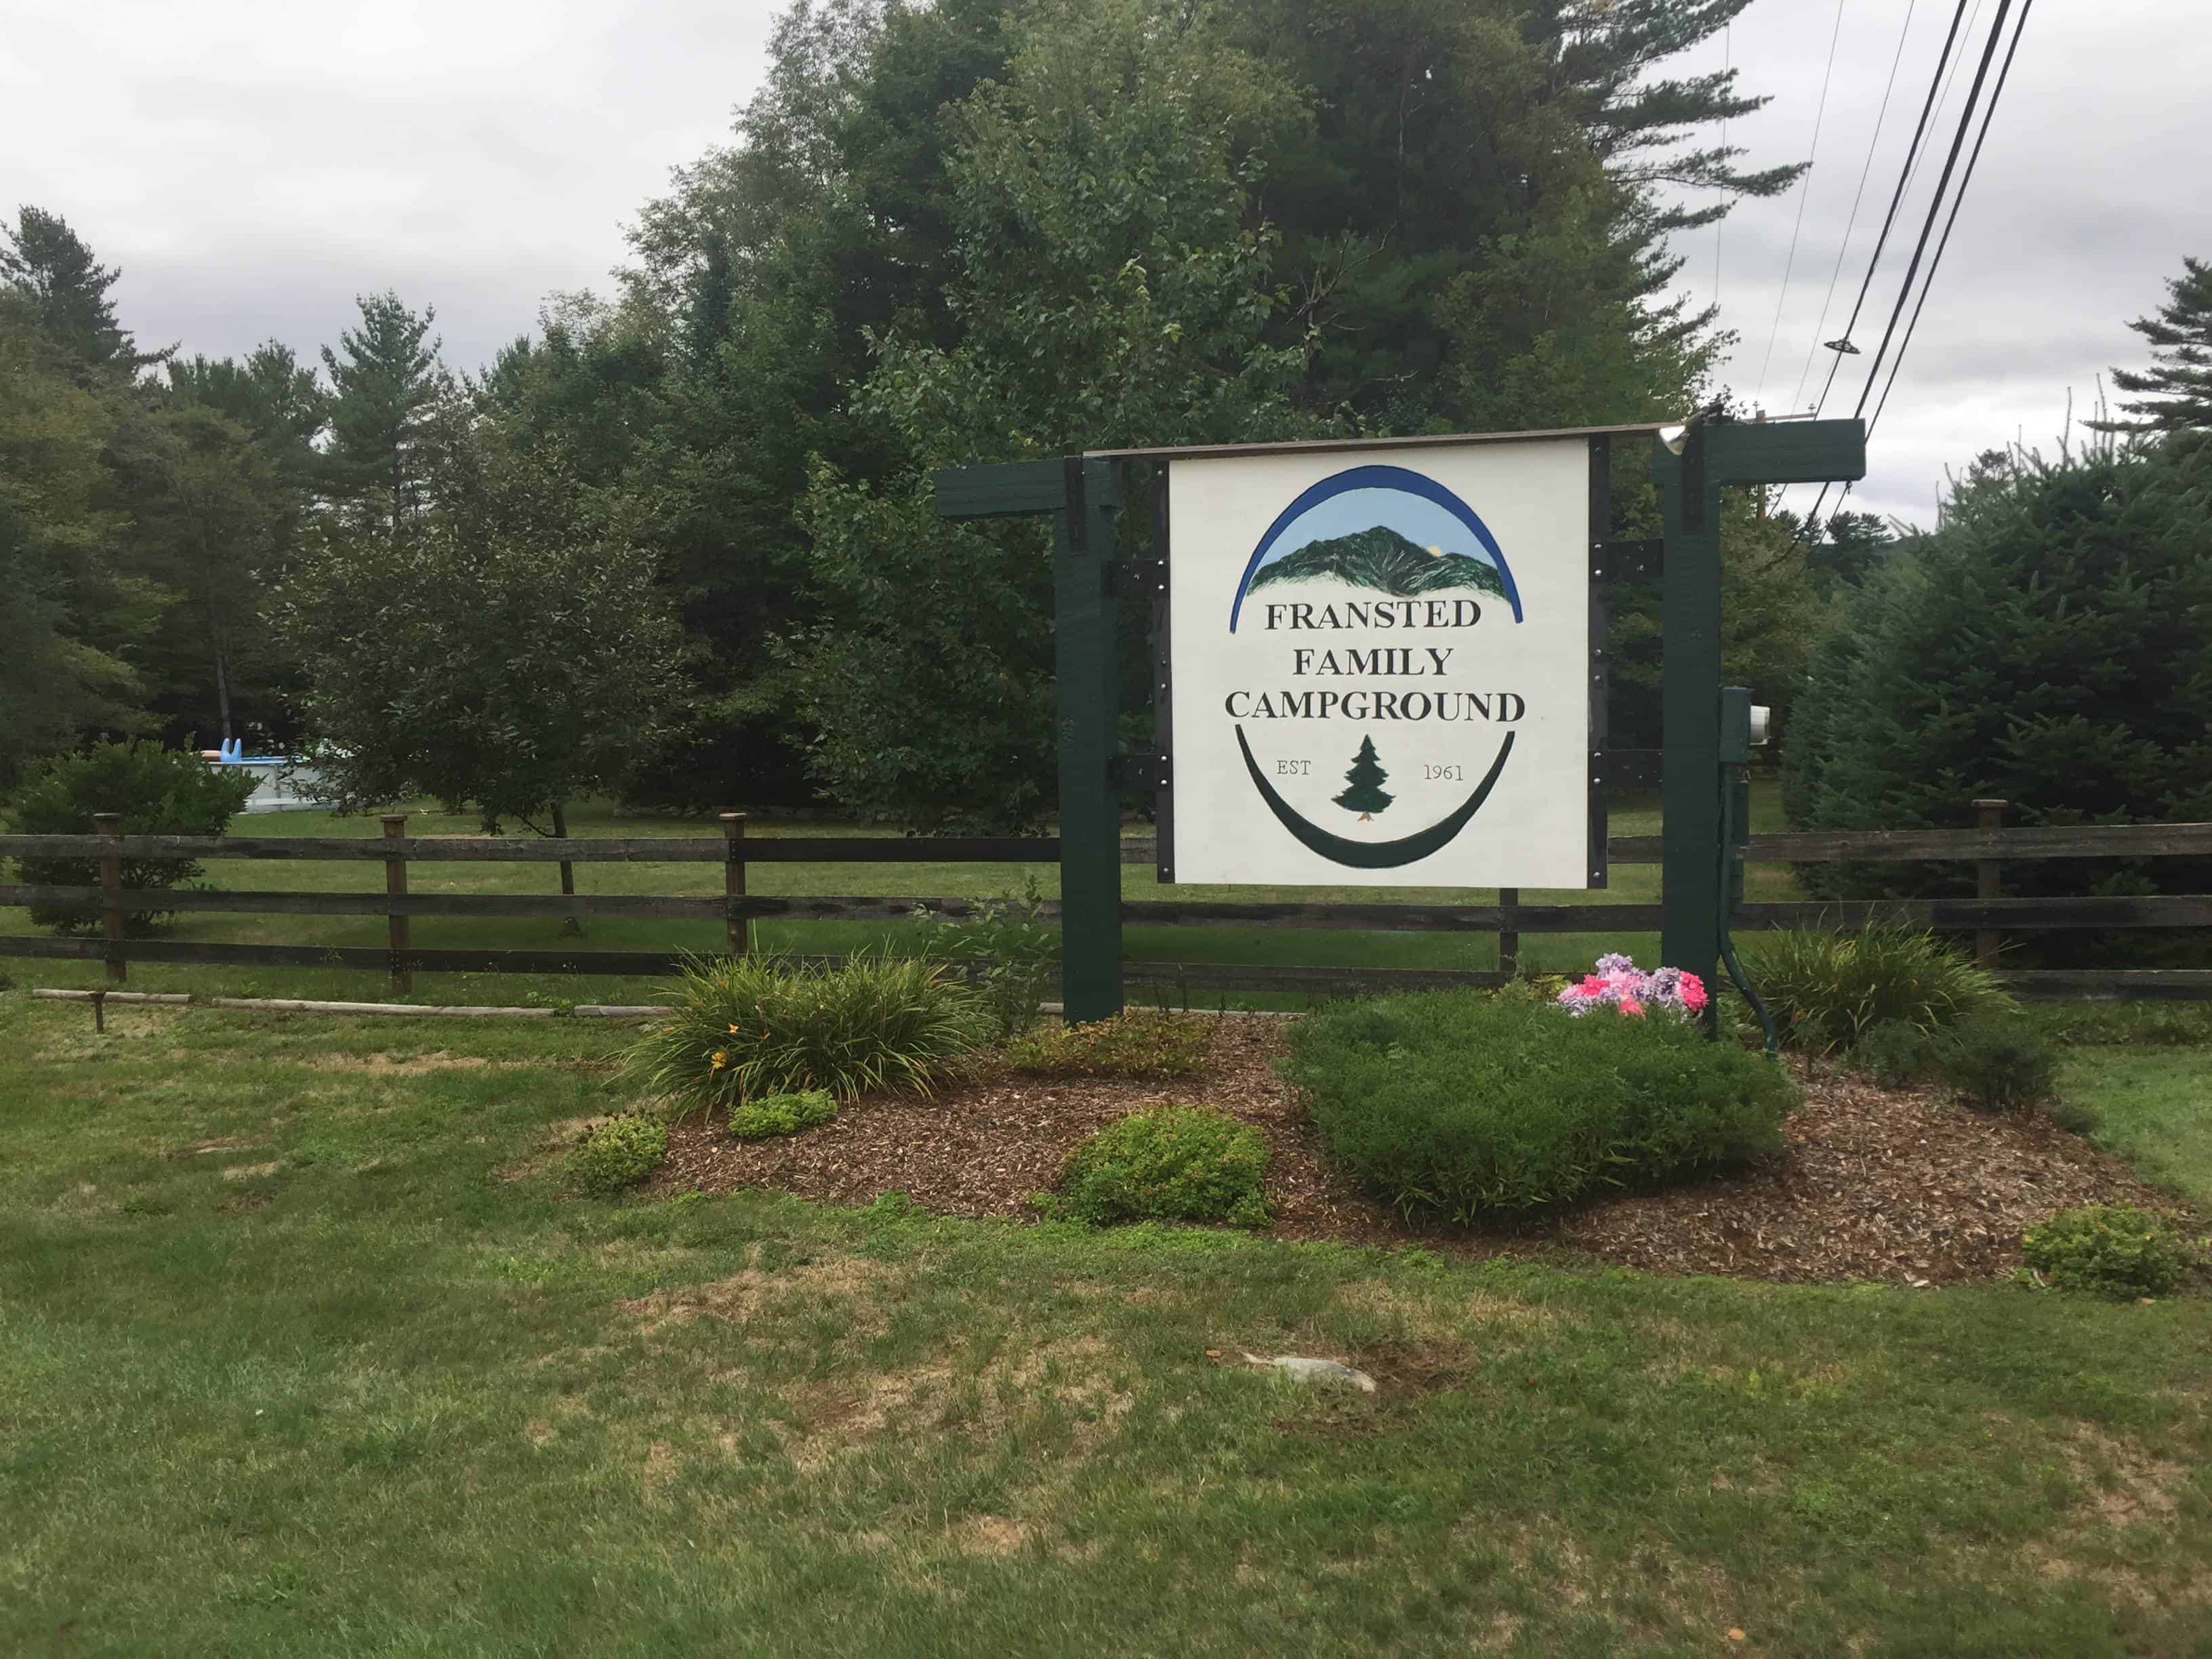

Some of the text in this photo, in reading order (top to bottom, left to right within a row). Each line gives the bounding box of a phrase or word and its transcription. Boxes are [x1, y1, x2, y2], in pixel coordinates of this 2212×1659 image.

[1265, 600, 1481, 630] FRANSTED
[1292, 648, 1454, 676] FAMILY
[1225, 691, 1525, 722] CAMPGROUND
[1276, 760, 1464, 781] EST 1961
